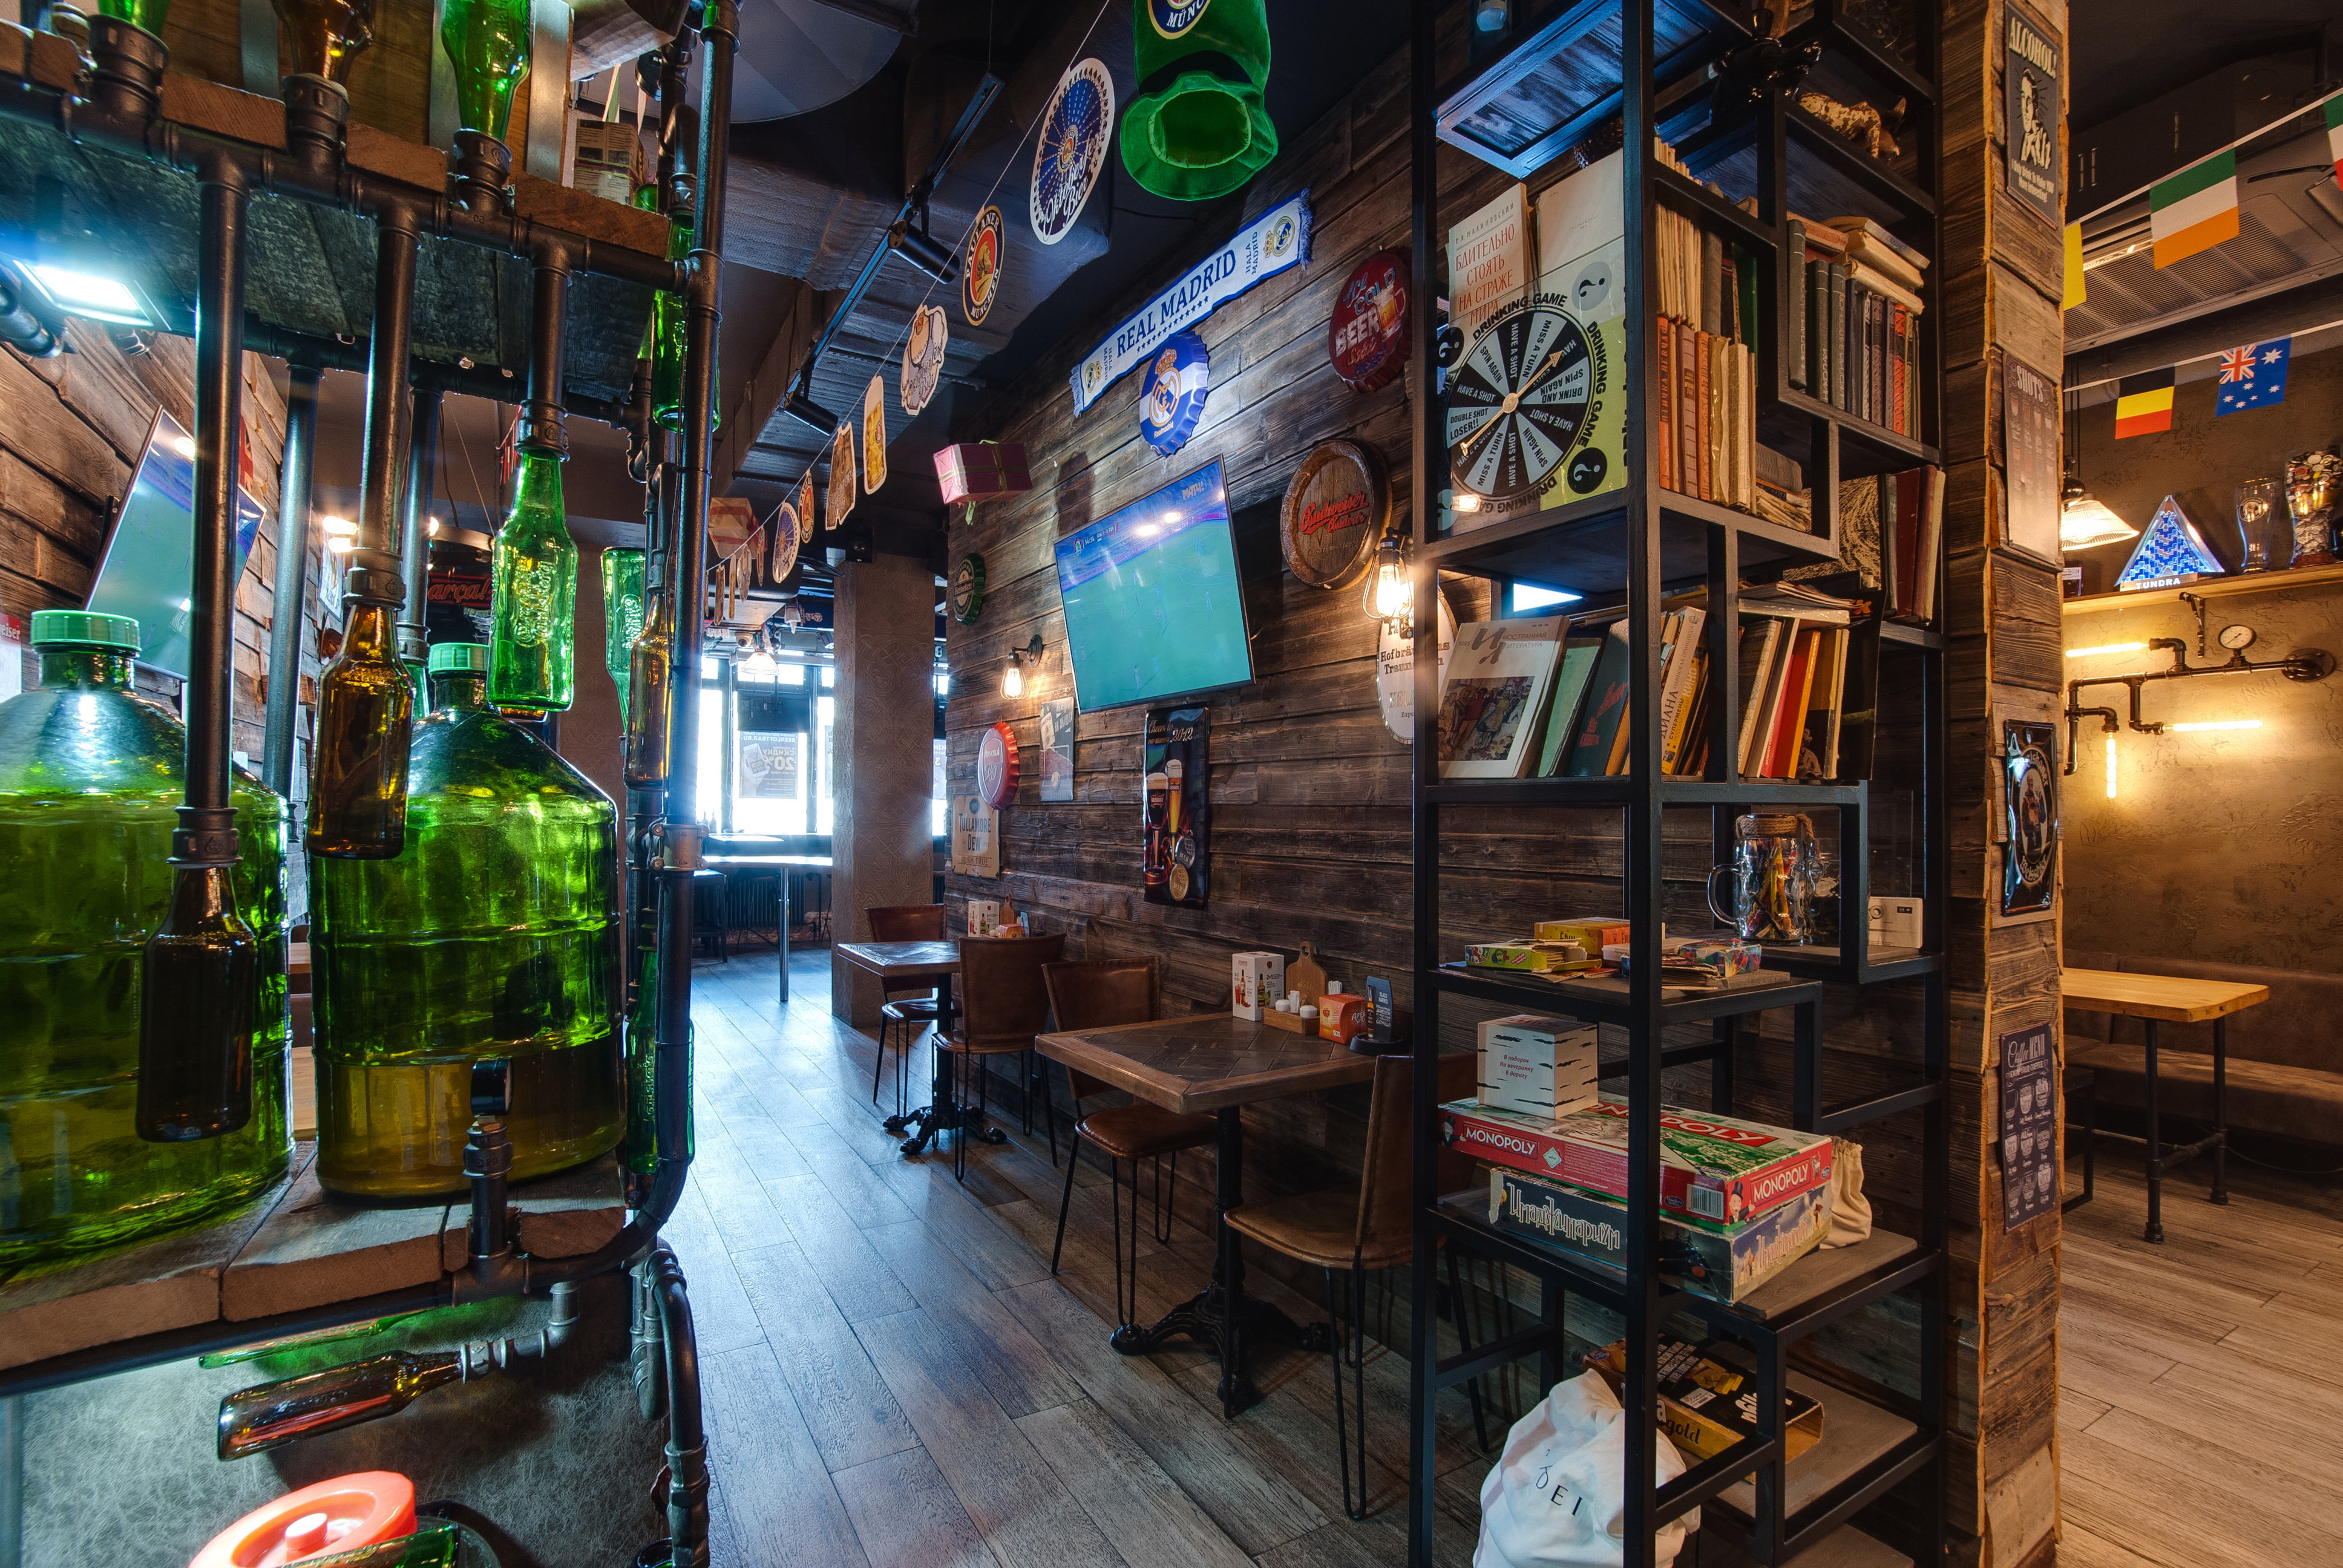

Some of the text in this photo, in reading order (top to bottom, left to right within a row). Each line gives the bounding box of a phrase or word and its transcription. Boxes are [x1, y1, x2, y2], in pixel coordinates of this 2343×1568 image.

[2009, 16, 2057, 79] ALCOHOL!
[966, 212, 1000, 279] PAULANER
[1455, 223, 1515, 272] БДИТЕЛЬНО
[1467, 254, 1504, 286] СТОЯТЬ
[970, 269, 1000, 318] MÜNCHEN
[1116, 249, 1236, 358] REAL MADRID
[1354, 267, 1395, 315] COLD
[1458, 269, 1513, 313] НА СТРАЖЕ
[1470, 299, 1499, 326] МИРА
[1473, 293, 1567, 341] DRINKING GAME
[1335, 305, 1380, 358] BEER
[1537, 320, 1552, 345] MISS
[1480, 345, 1502, 384] SPIN AGAIN
[1522, 354, 1538, 378] TURN
[1457, 384, 1472, 397] HAVE
[1480, 392, 1496, 403] SHOT
[1541, 368, 1584, 397] SPIN AGAIN
[1542, 387, 1582, 403] DRINK AND
[1578, 321, 1607, 448] DRINKING GAME
[2017, 365, 2043, 402] SHOTS
[1450, 408, 1489, 424] DOUBLE SHOT
[1530, 408, 1546, 420] SHOT
[1555, 417, 1574, 431] HAVE
[1450, 419, 1479, 440] LOSER!!
[1477, 464, 1490, 486] MISS
[1489, 432, 1504, 457] TURN
[1523, 427, 1548, 468] SPIN AGAIN
[1497, 476, 1557, 513] DRINKING
[1300, 491, 1369, 535] Budweiser
[427, 577, 491, 603] arça!
[2135, 577, 2181, 590] TUNDRA
[1380, 642, 1450, 662] Hofbräus
[1384, 657, 1444, 675] Traunn
[1682, 667, 1698, 697] КИНО
[1668, 697, 1685, 740] СУПЕРМЕНЫ
[1172, 727, 1193, 742] 2012
[984, 747, 1000, 757] Arsenal
[959, 813, 991, 834] TULLAMORE
[968, 835, 981, 852] DEW
[961, 856, 988, 866] IRISH TRUE
[2029, 1033, 2045, 1060] MENU
[1507, 1063, 1534, 1073] вечеринку
[1510, 1071, 1528, 1079] дорогу
[1466, 1126, 1536, 1156] MONOPOLY
[1753, 1163, 1809, 1201] MONOPOLY
[1506, 1182, 1620, 1250] Имаджинариум
[1666, 1417, 1701, 1445] gold
